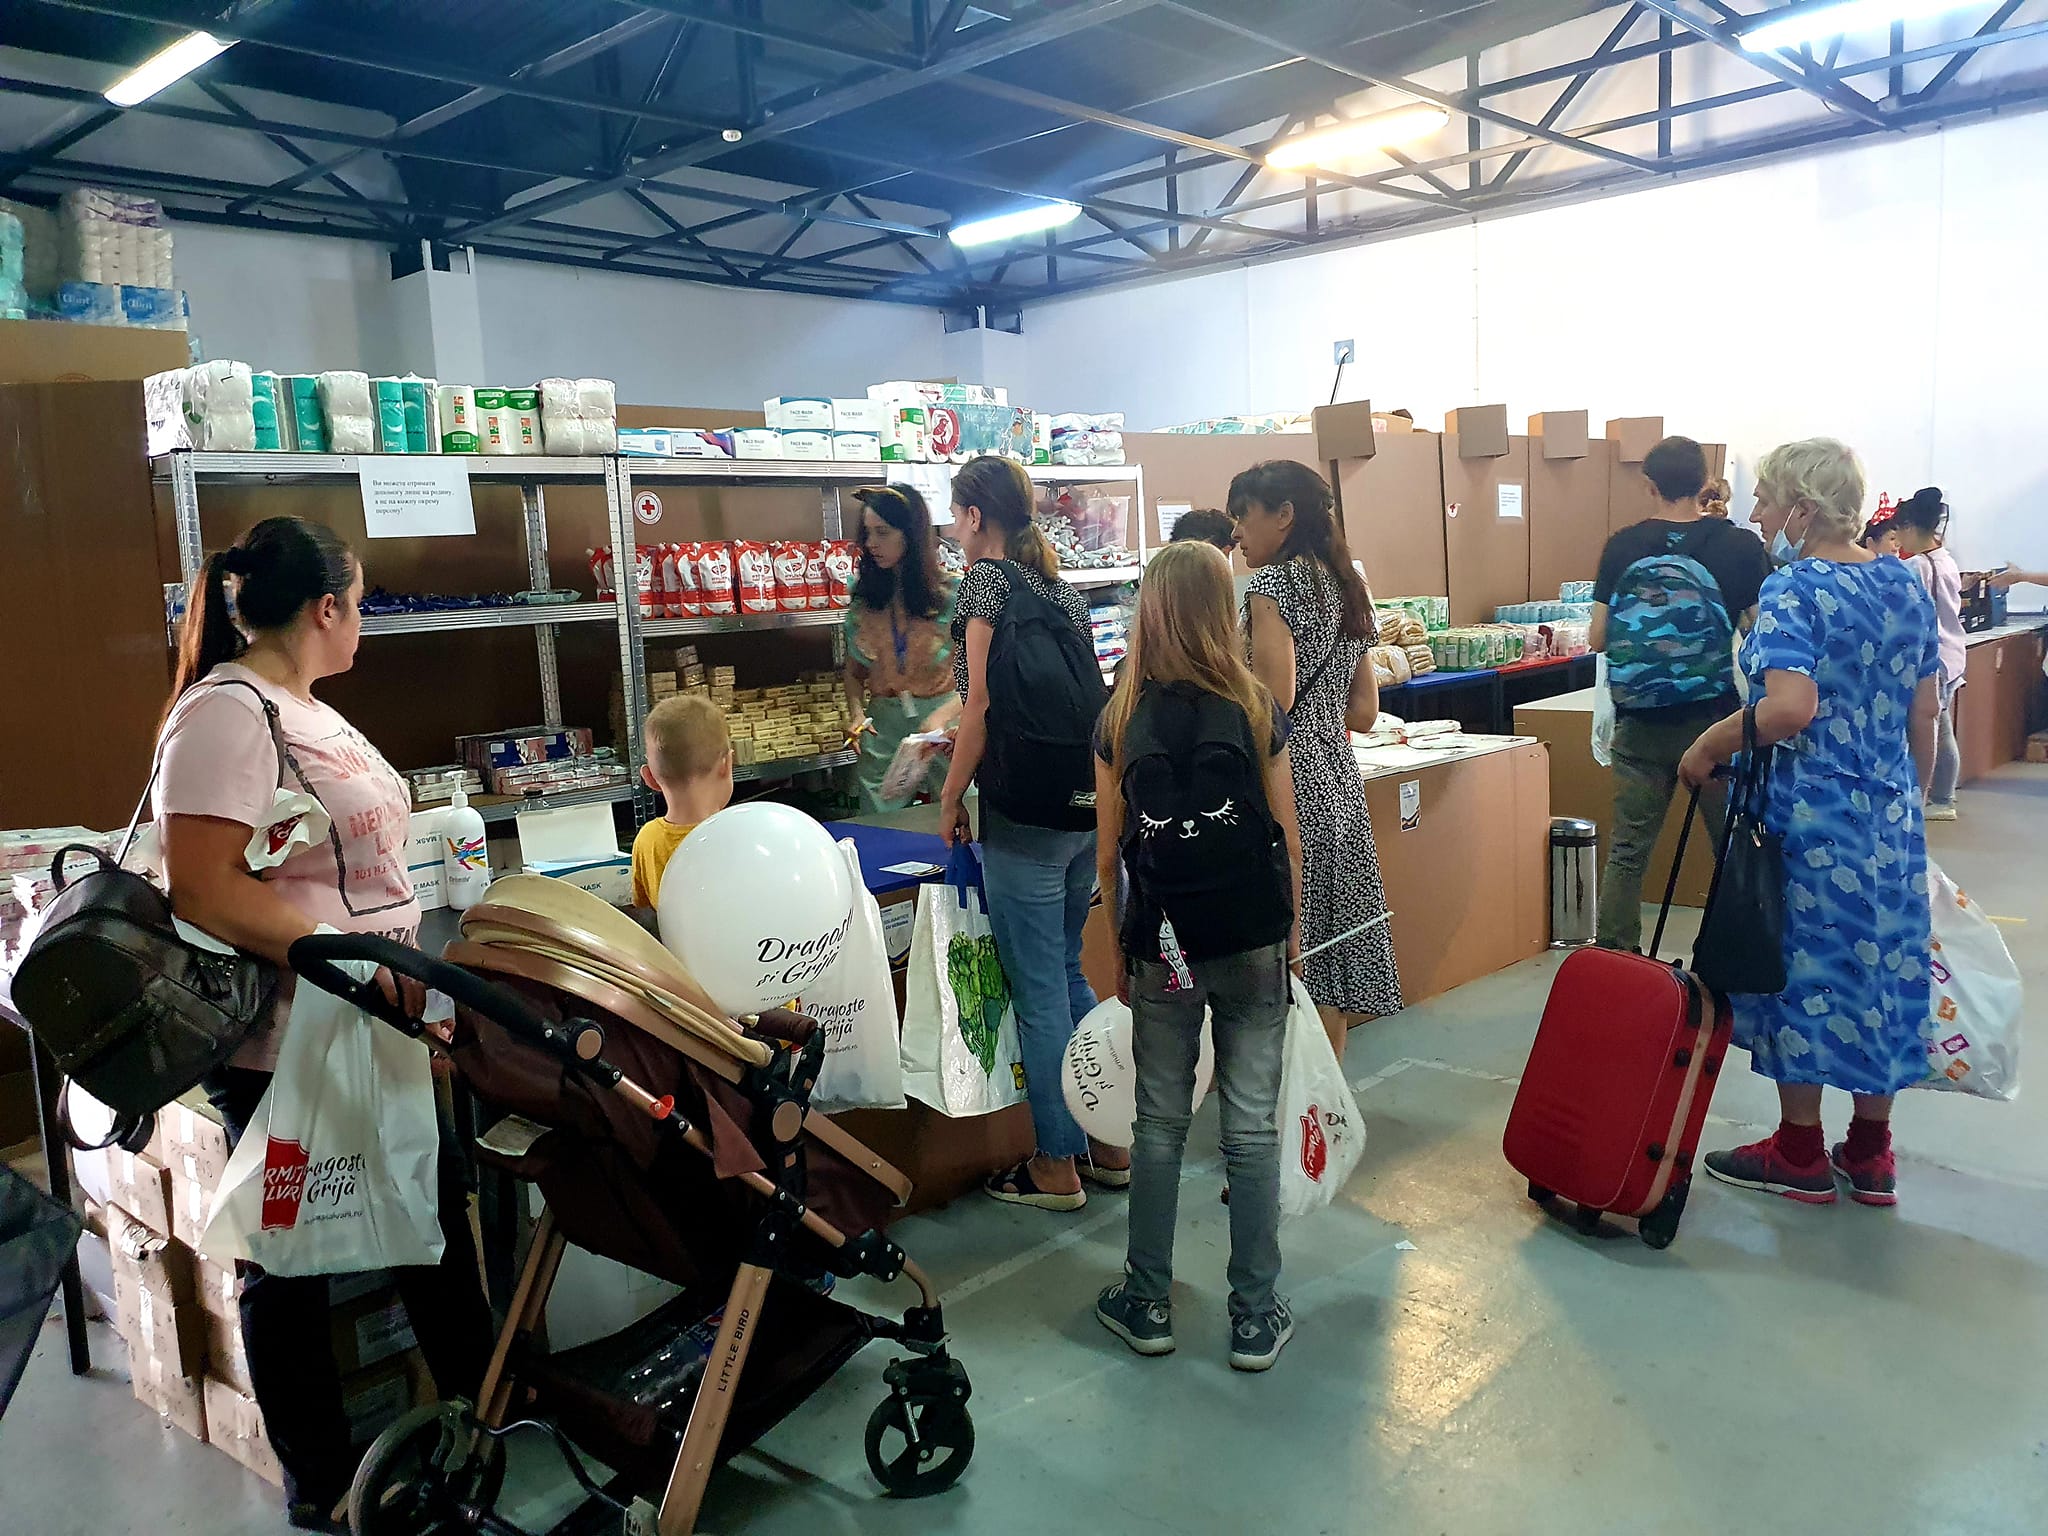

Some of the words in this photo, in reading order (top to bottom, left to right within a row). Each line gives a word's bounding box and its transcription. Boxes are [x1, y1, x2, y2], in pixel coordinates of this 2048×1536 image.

[420, 880, 440, 889] MASK
[717, 1343, 739, 1393] LITTLE
[734, 1308, 750, 1340] BIRD
